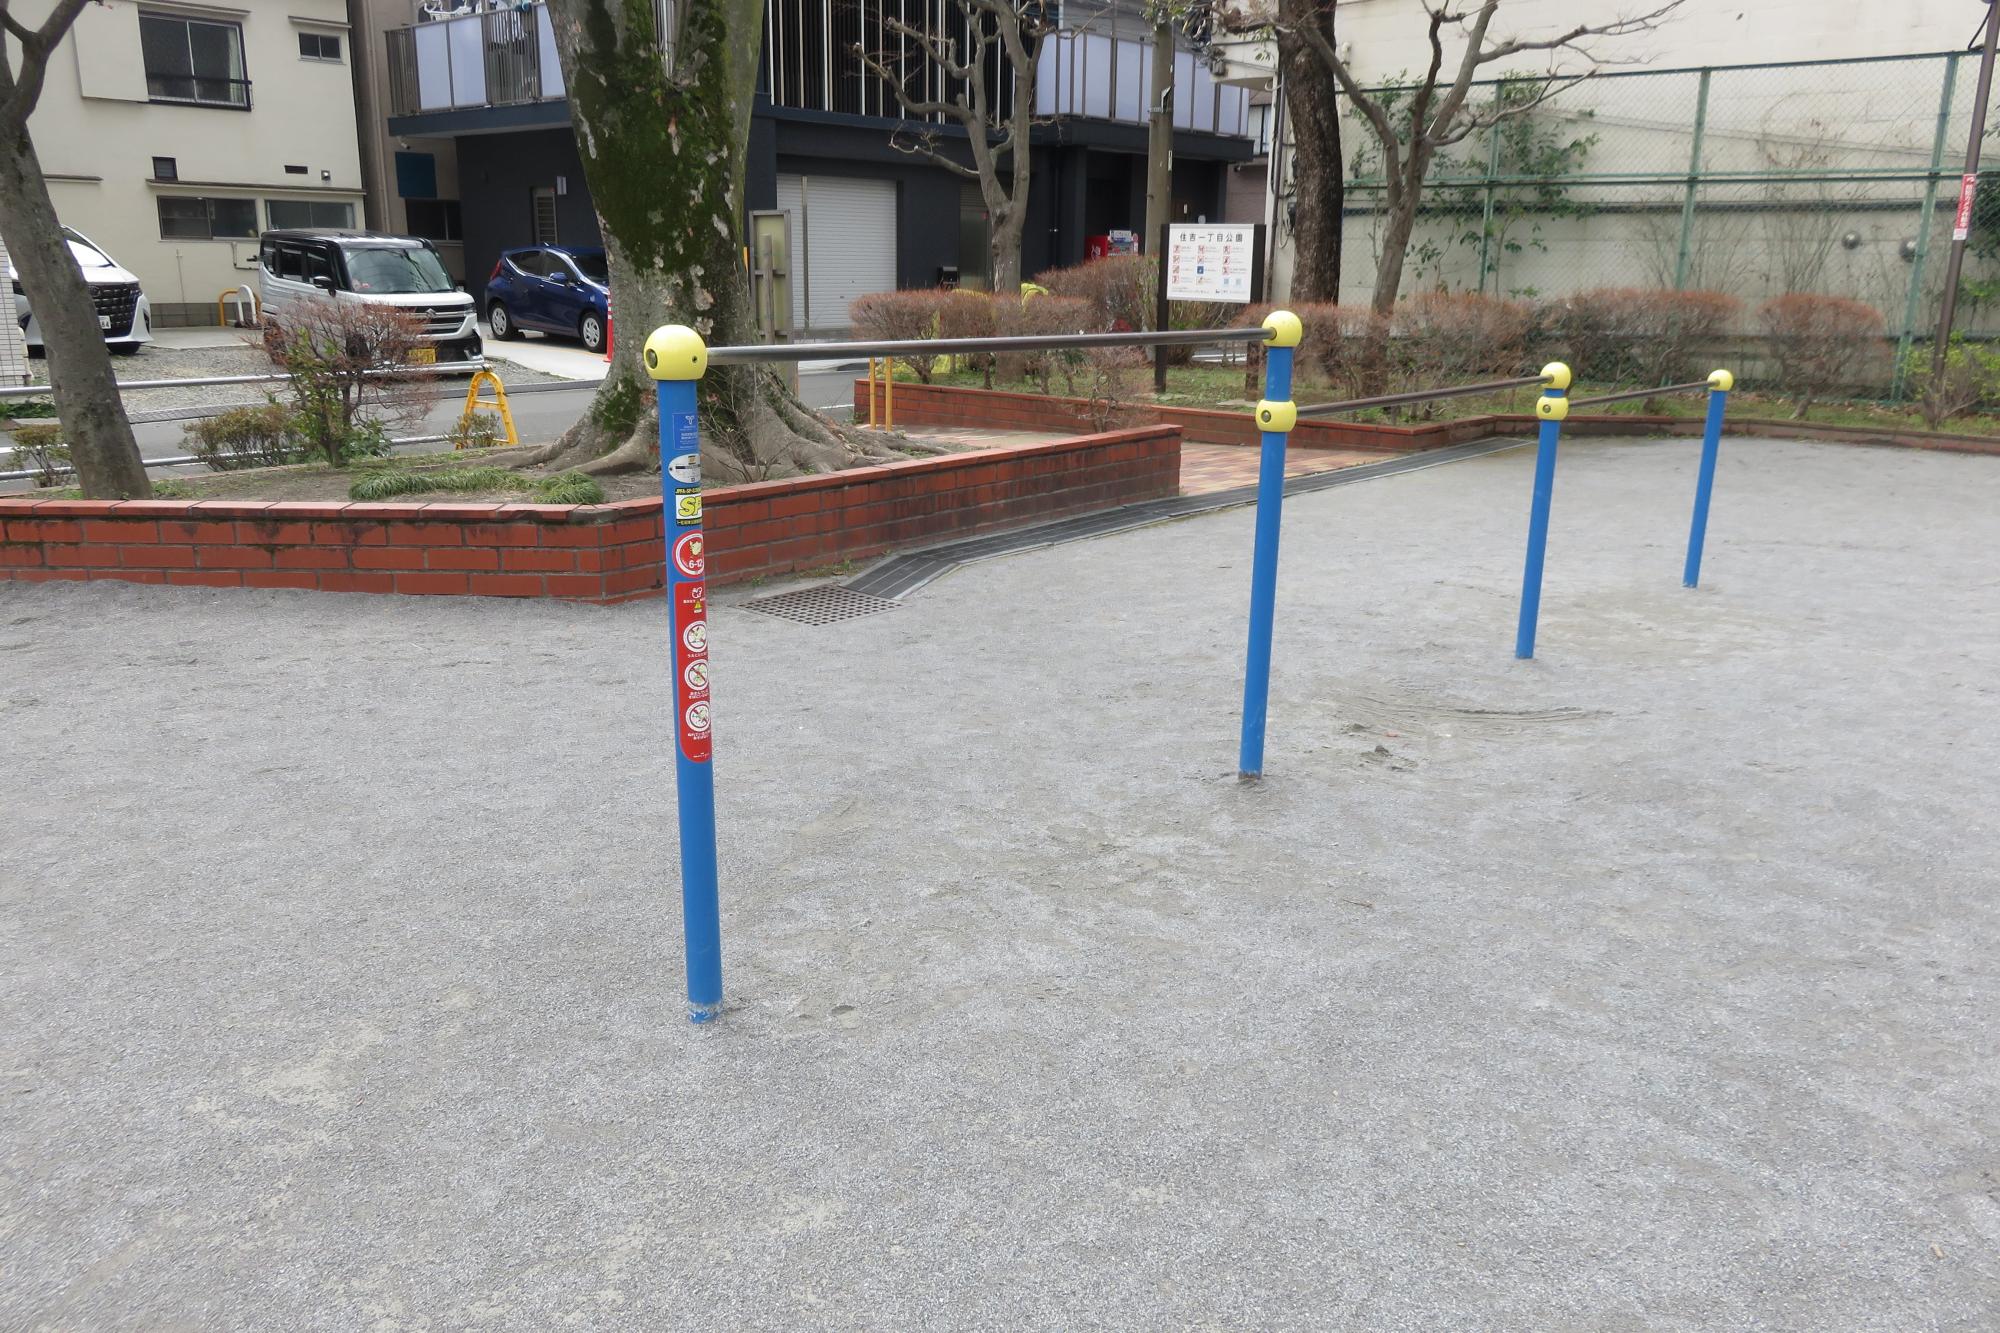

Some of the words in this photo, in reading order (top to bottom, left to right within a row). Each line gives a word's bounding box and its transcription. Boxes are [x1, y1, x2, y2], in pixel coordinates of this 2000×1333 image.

[1179, 232, 1244, 243] 住吉一丁目公園
